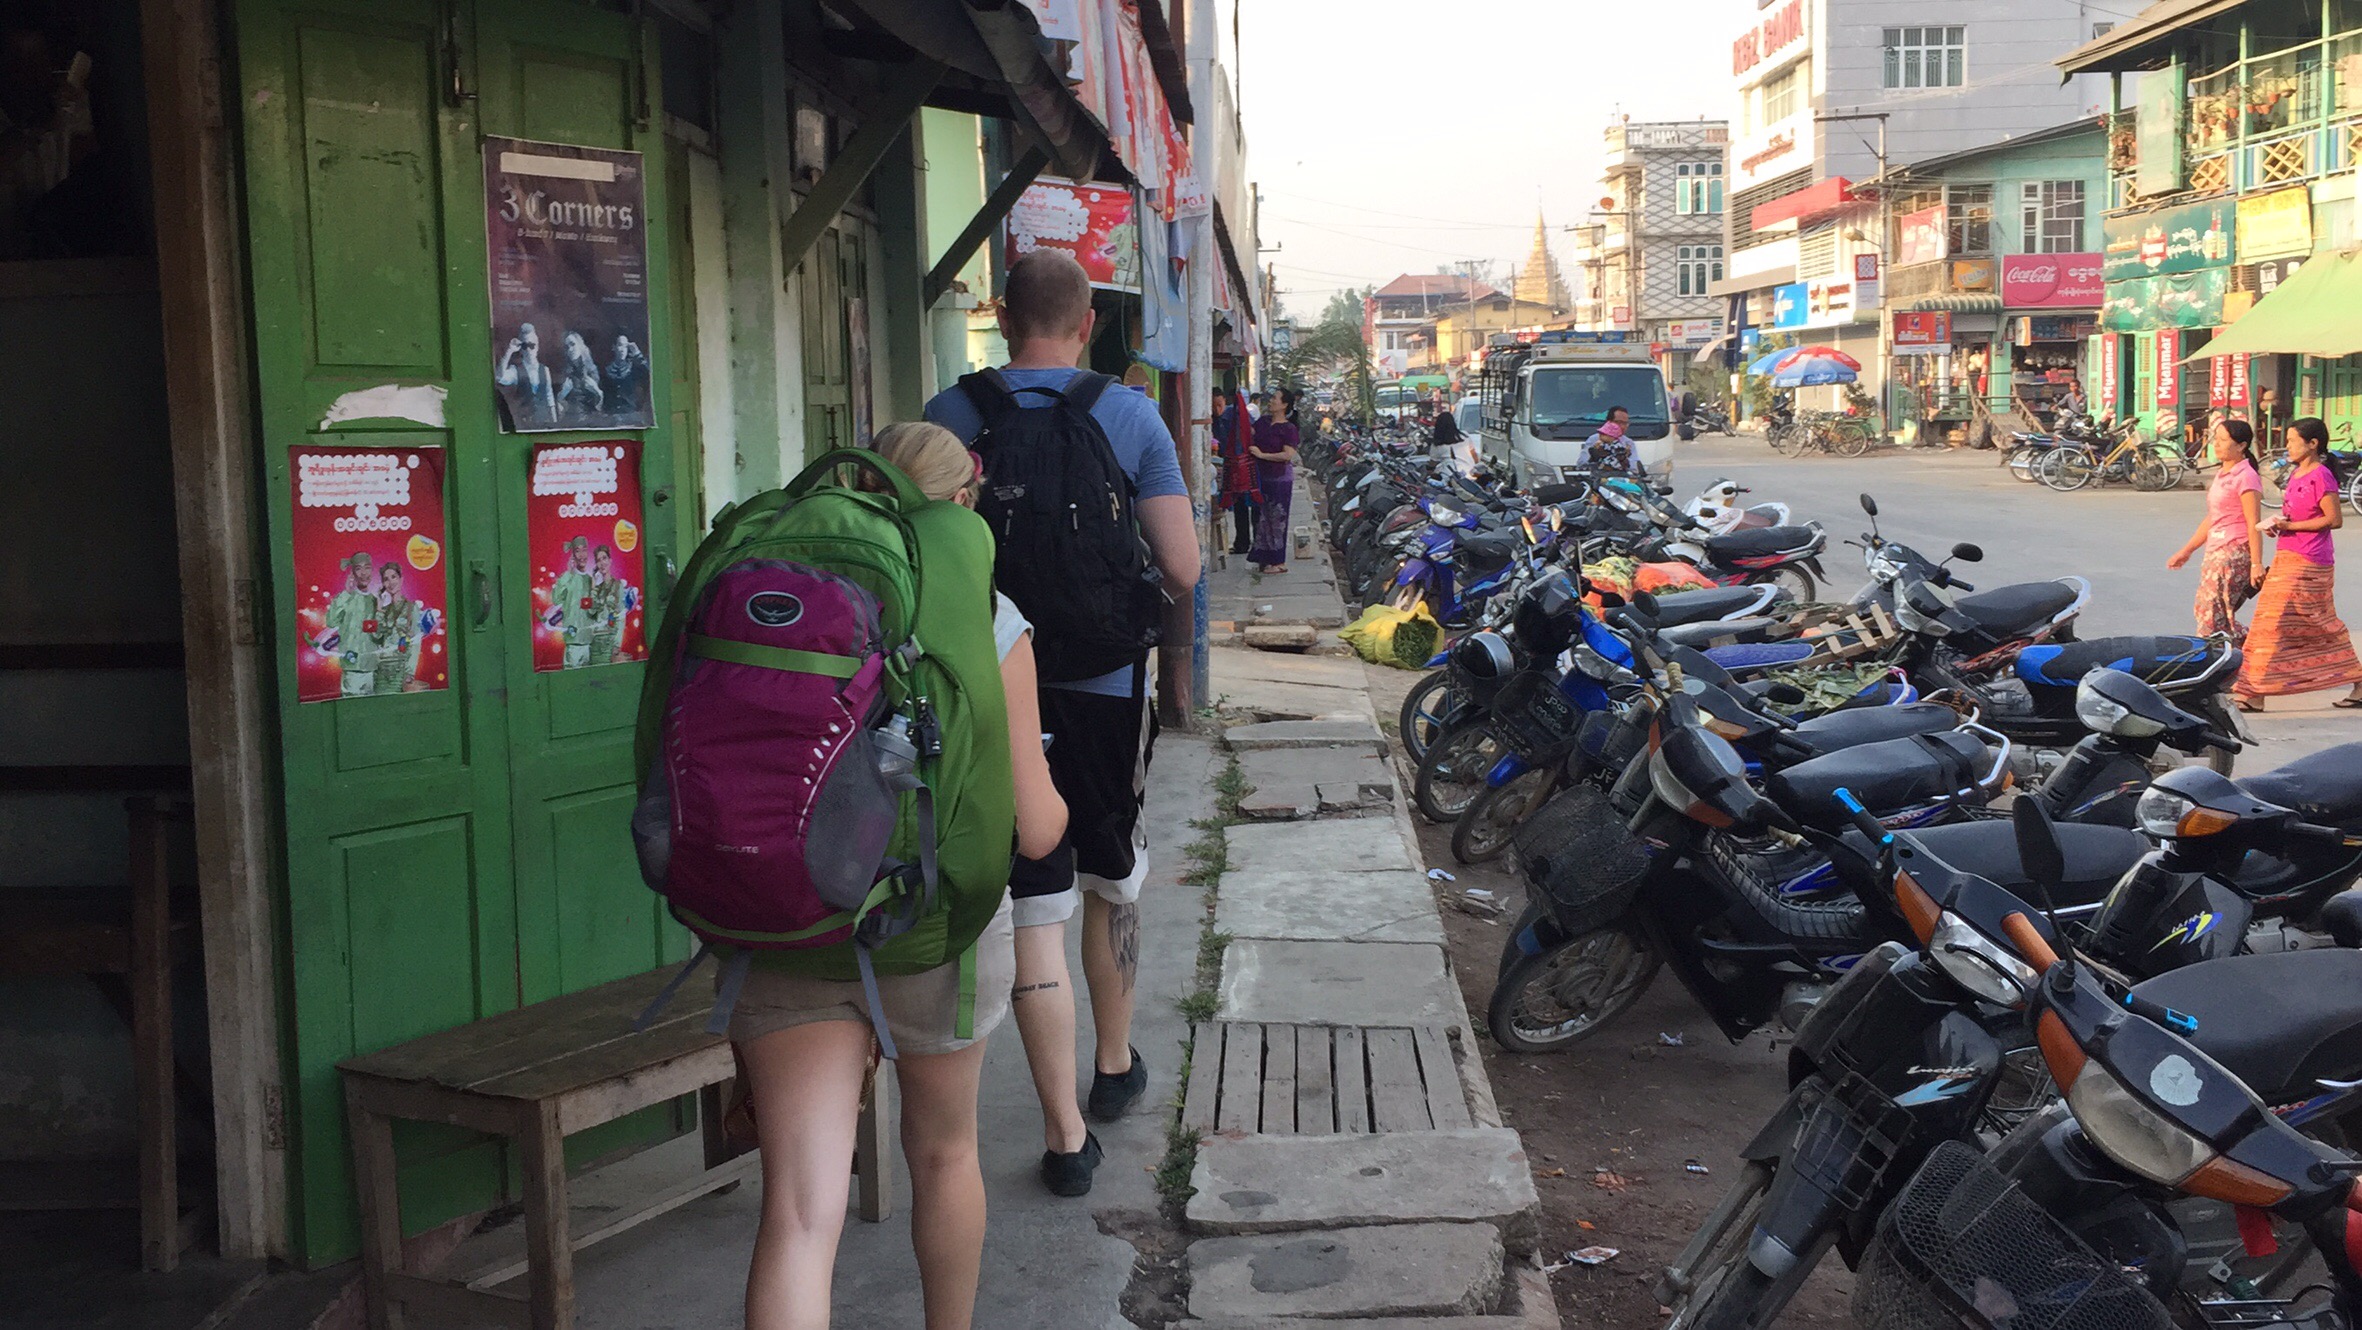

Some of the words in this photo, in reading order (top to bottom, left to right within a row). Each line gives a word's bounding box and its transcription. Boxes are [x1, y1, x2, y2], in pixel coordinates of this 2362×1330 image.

[500, 183, 520, 223] 3
[525, 190, 634, 230] Corners
[2006, 265, 2058, 284] Coca-Cola
[2102, 339, 2115, 399] Myanmar
[2158, 336, 2174, 399] Myanmar
[336, 518, 410, 530] ooredoo
